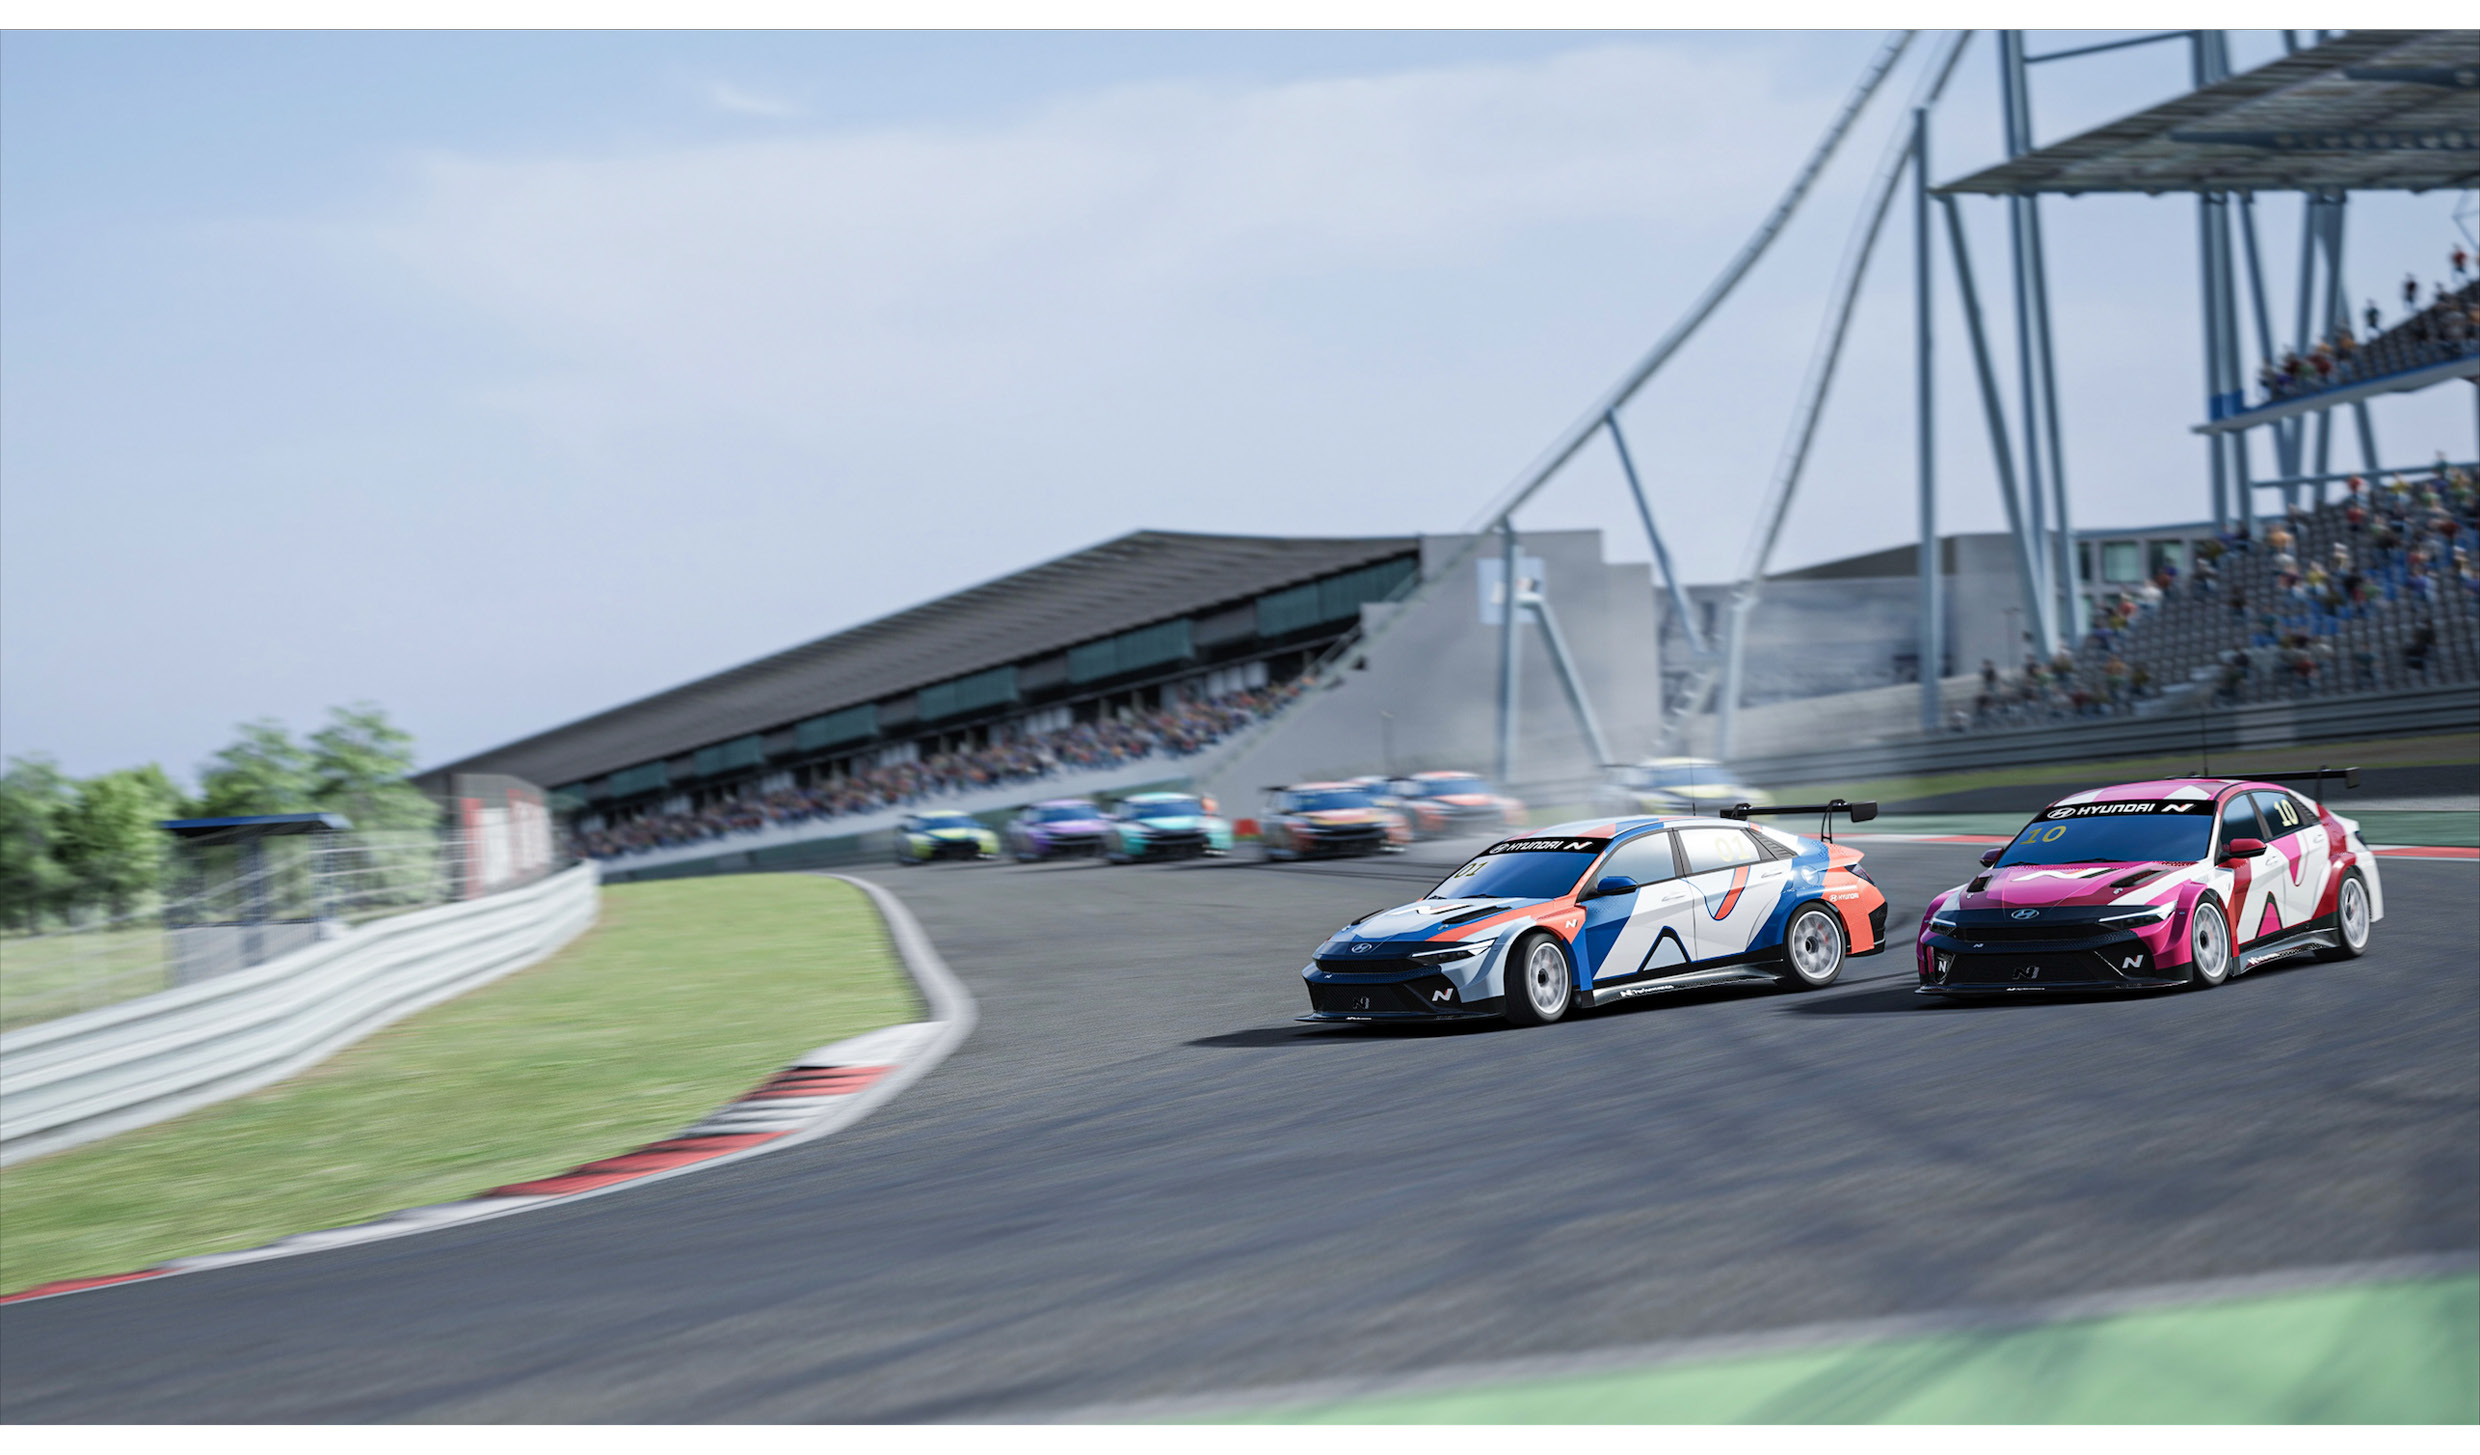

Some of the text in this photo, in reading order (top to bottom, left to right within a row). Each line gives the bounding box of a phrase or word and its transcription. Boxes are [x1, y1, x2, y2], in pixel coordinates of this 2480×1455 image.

[2077, 803, 2197, 815] HYUNDAI N
[2274, 799, 2299, 827] 10
[2020, 825, 2067, 845] 10
[1507, 841, 1564, 851] HYUNDAI
[1715, 836, 1752, 862] 01
[1454, 861, 1488, 879] 01
[1565, 919, 1578, 929] N
[1937, 960, 1948, 973] N
[2122, 954, 2144, 969] N
[1432, 988, 1454, 1002] N
